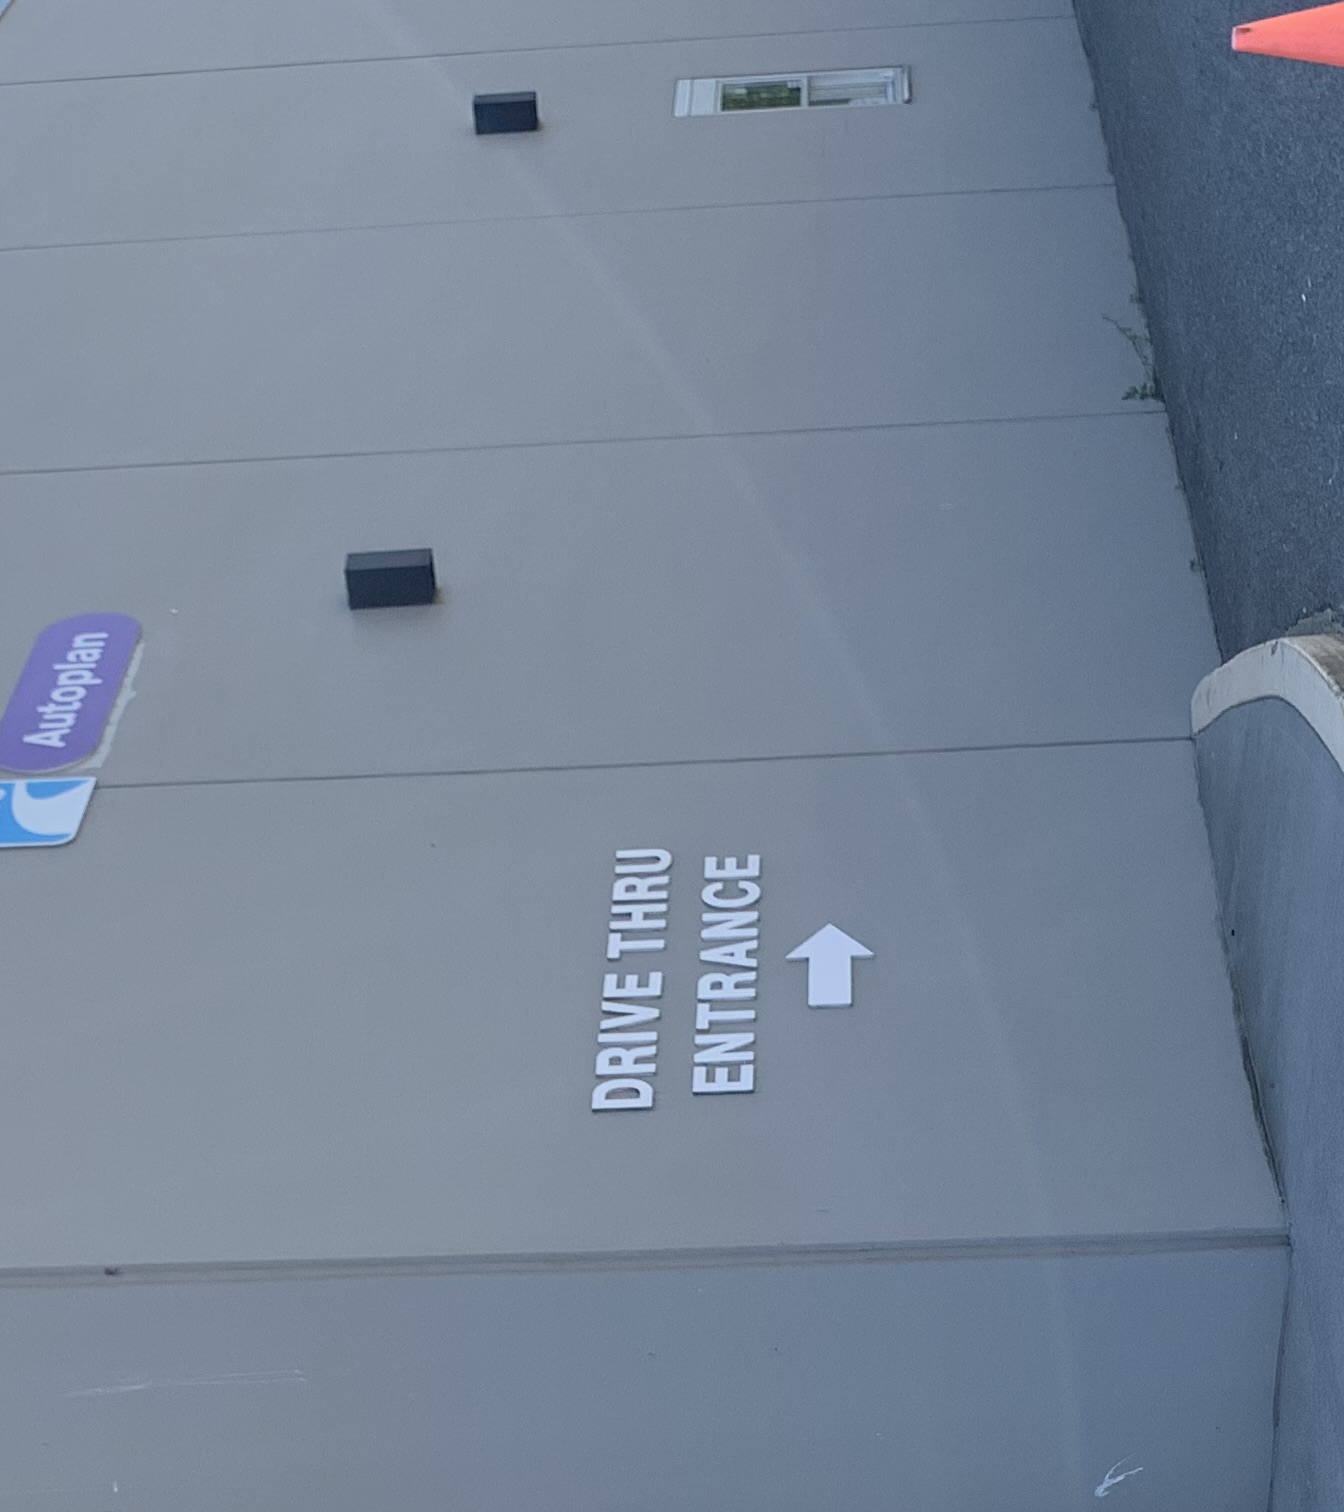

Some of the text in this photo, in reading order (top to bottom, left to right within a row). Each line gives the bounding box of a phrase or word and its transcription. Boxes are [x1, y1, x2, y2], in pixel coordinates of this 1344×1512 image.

[21, 631, 110, 748] Autoplan
[590, 848, 673, 1112] DRIVE THRU
[691, 853, 762, 1094] ENTRANCE
